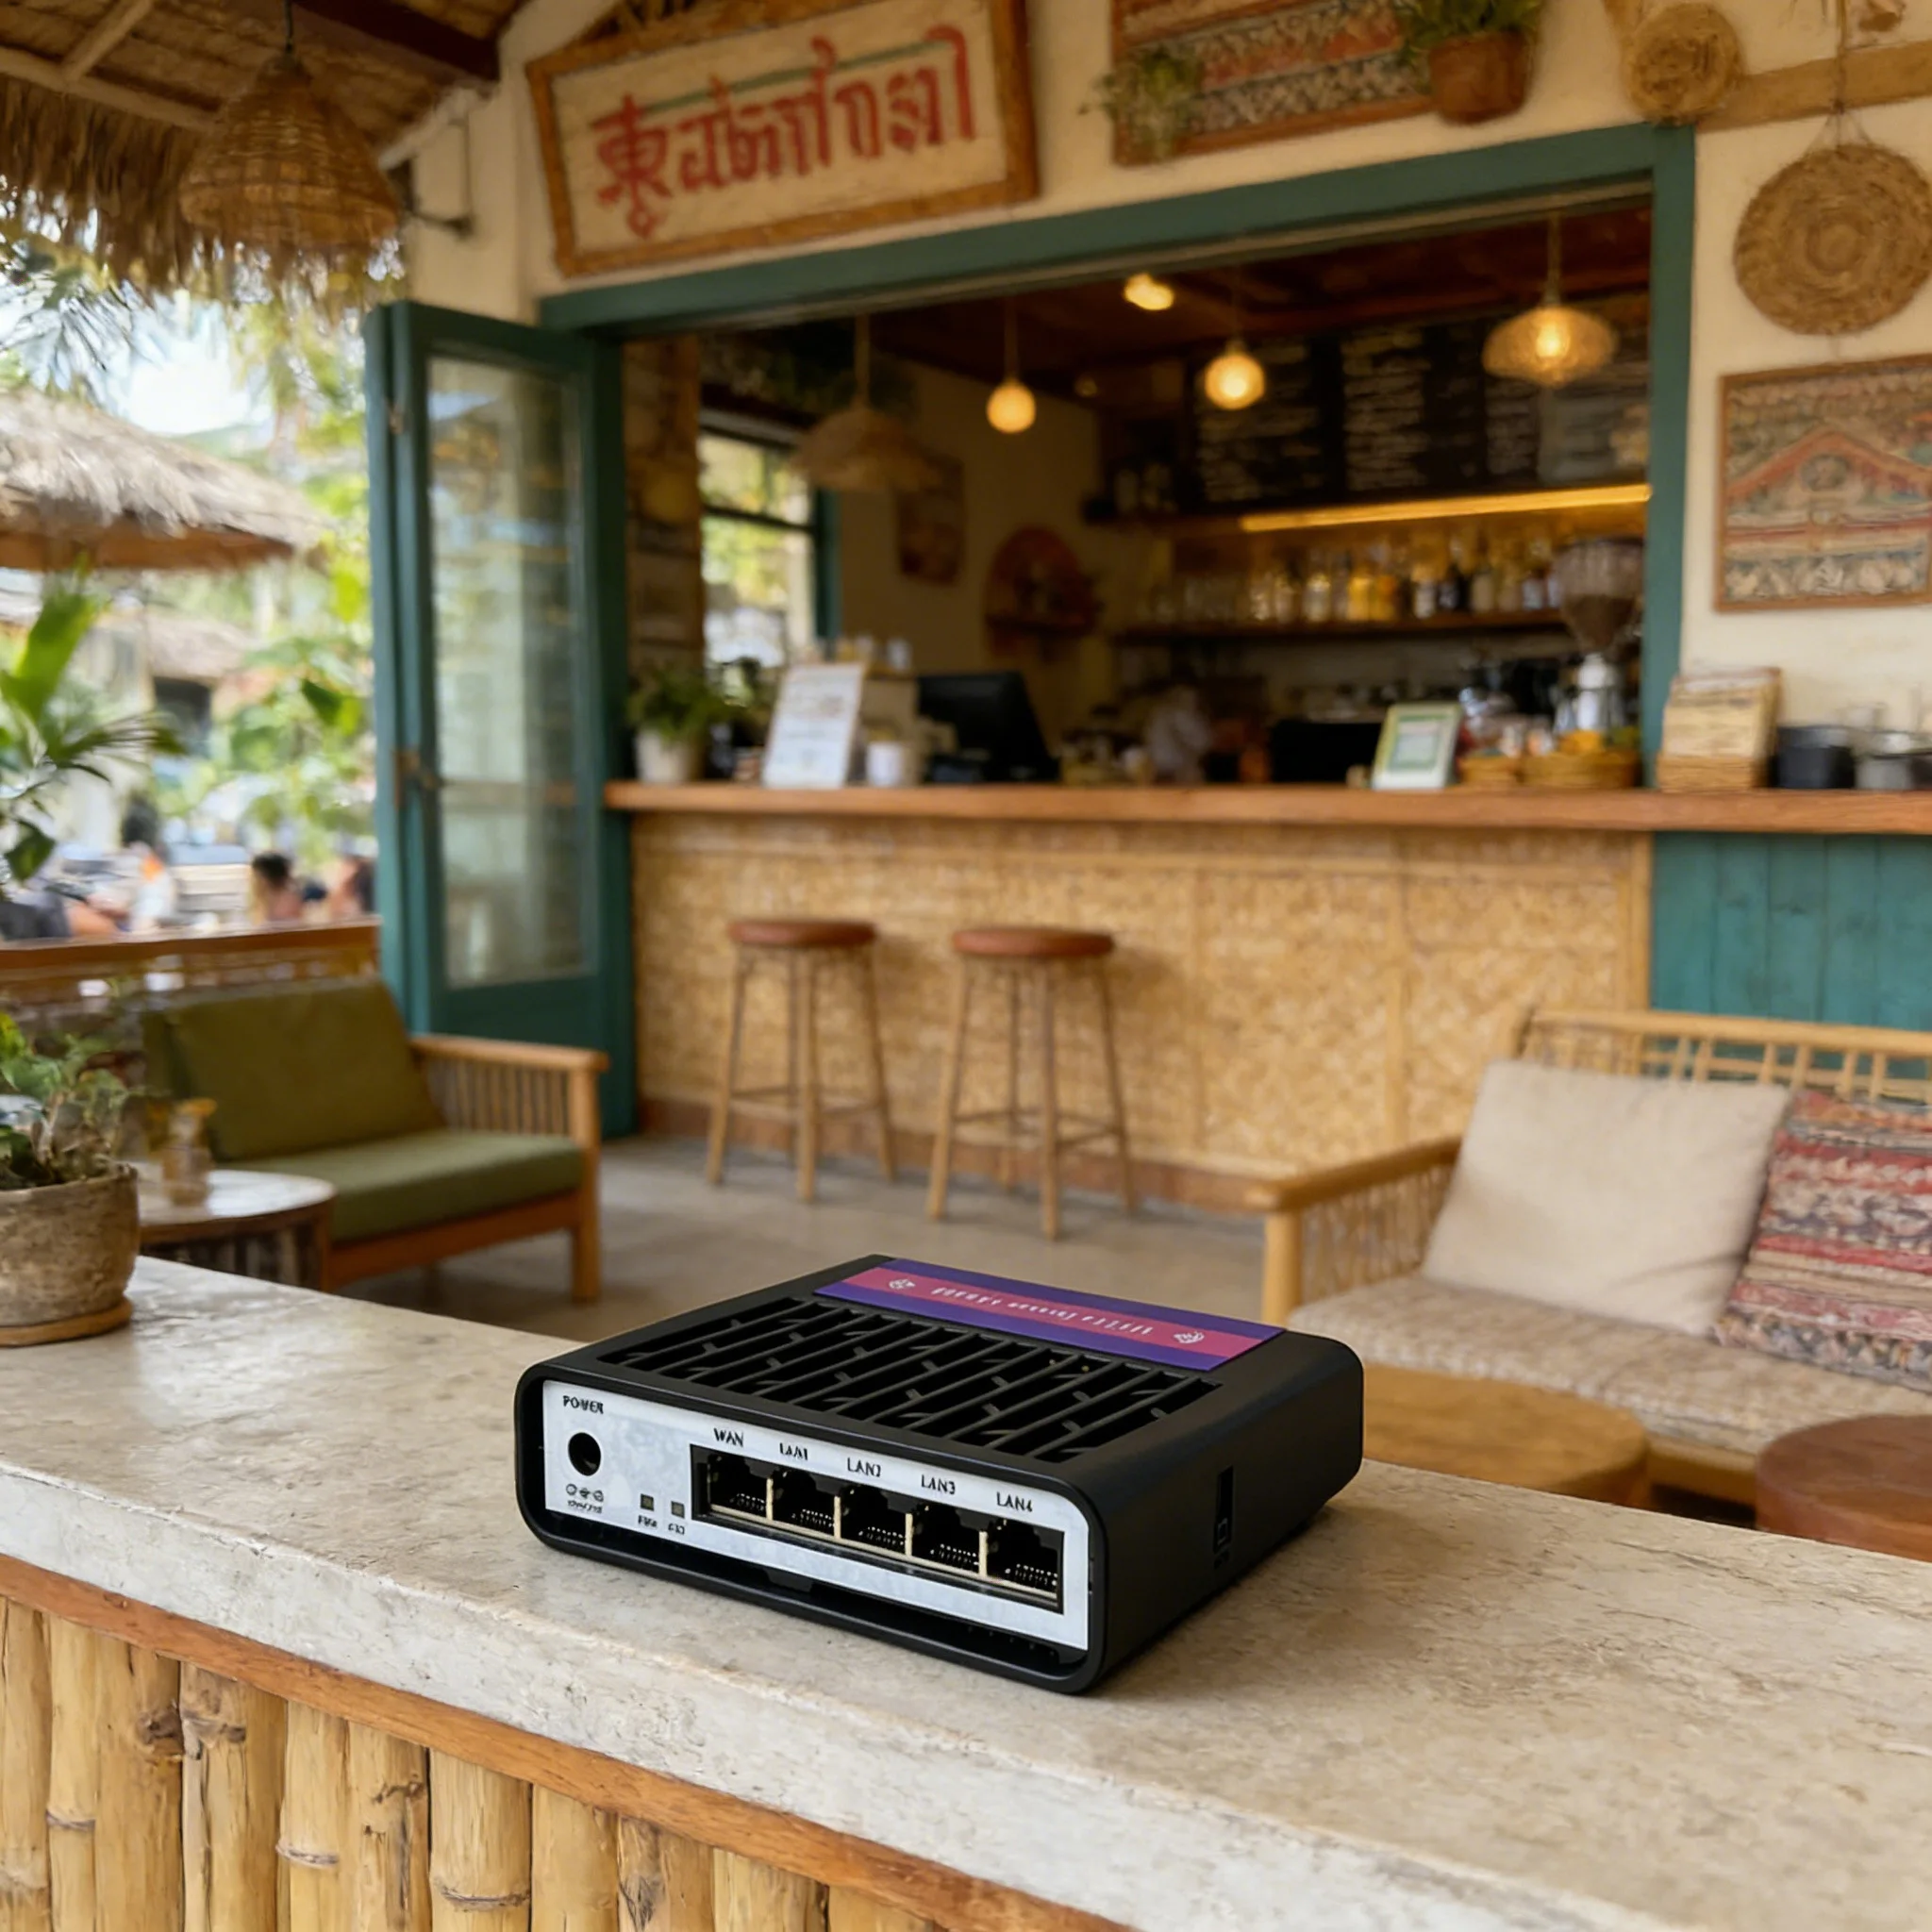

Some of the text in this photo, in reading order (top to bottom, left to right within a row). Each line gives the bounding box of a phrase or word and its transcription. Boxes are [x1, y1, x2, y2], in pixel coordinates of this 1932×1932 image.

[713, 1427, 744, 1448] WAN
[847, 1457, 882, 1477] LAN2
[921, 1474, 957, 1495] LAN3
[996, 1491, 1033, 1513] LAN4
